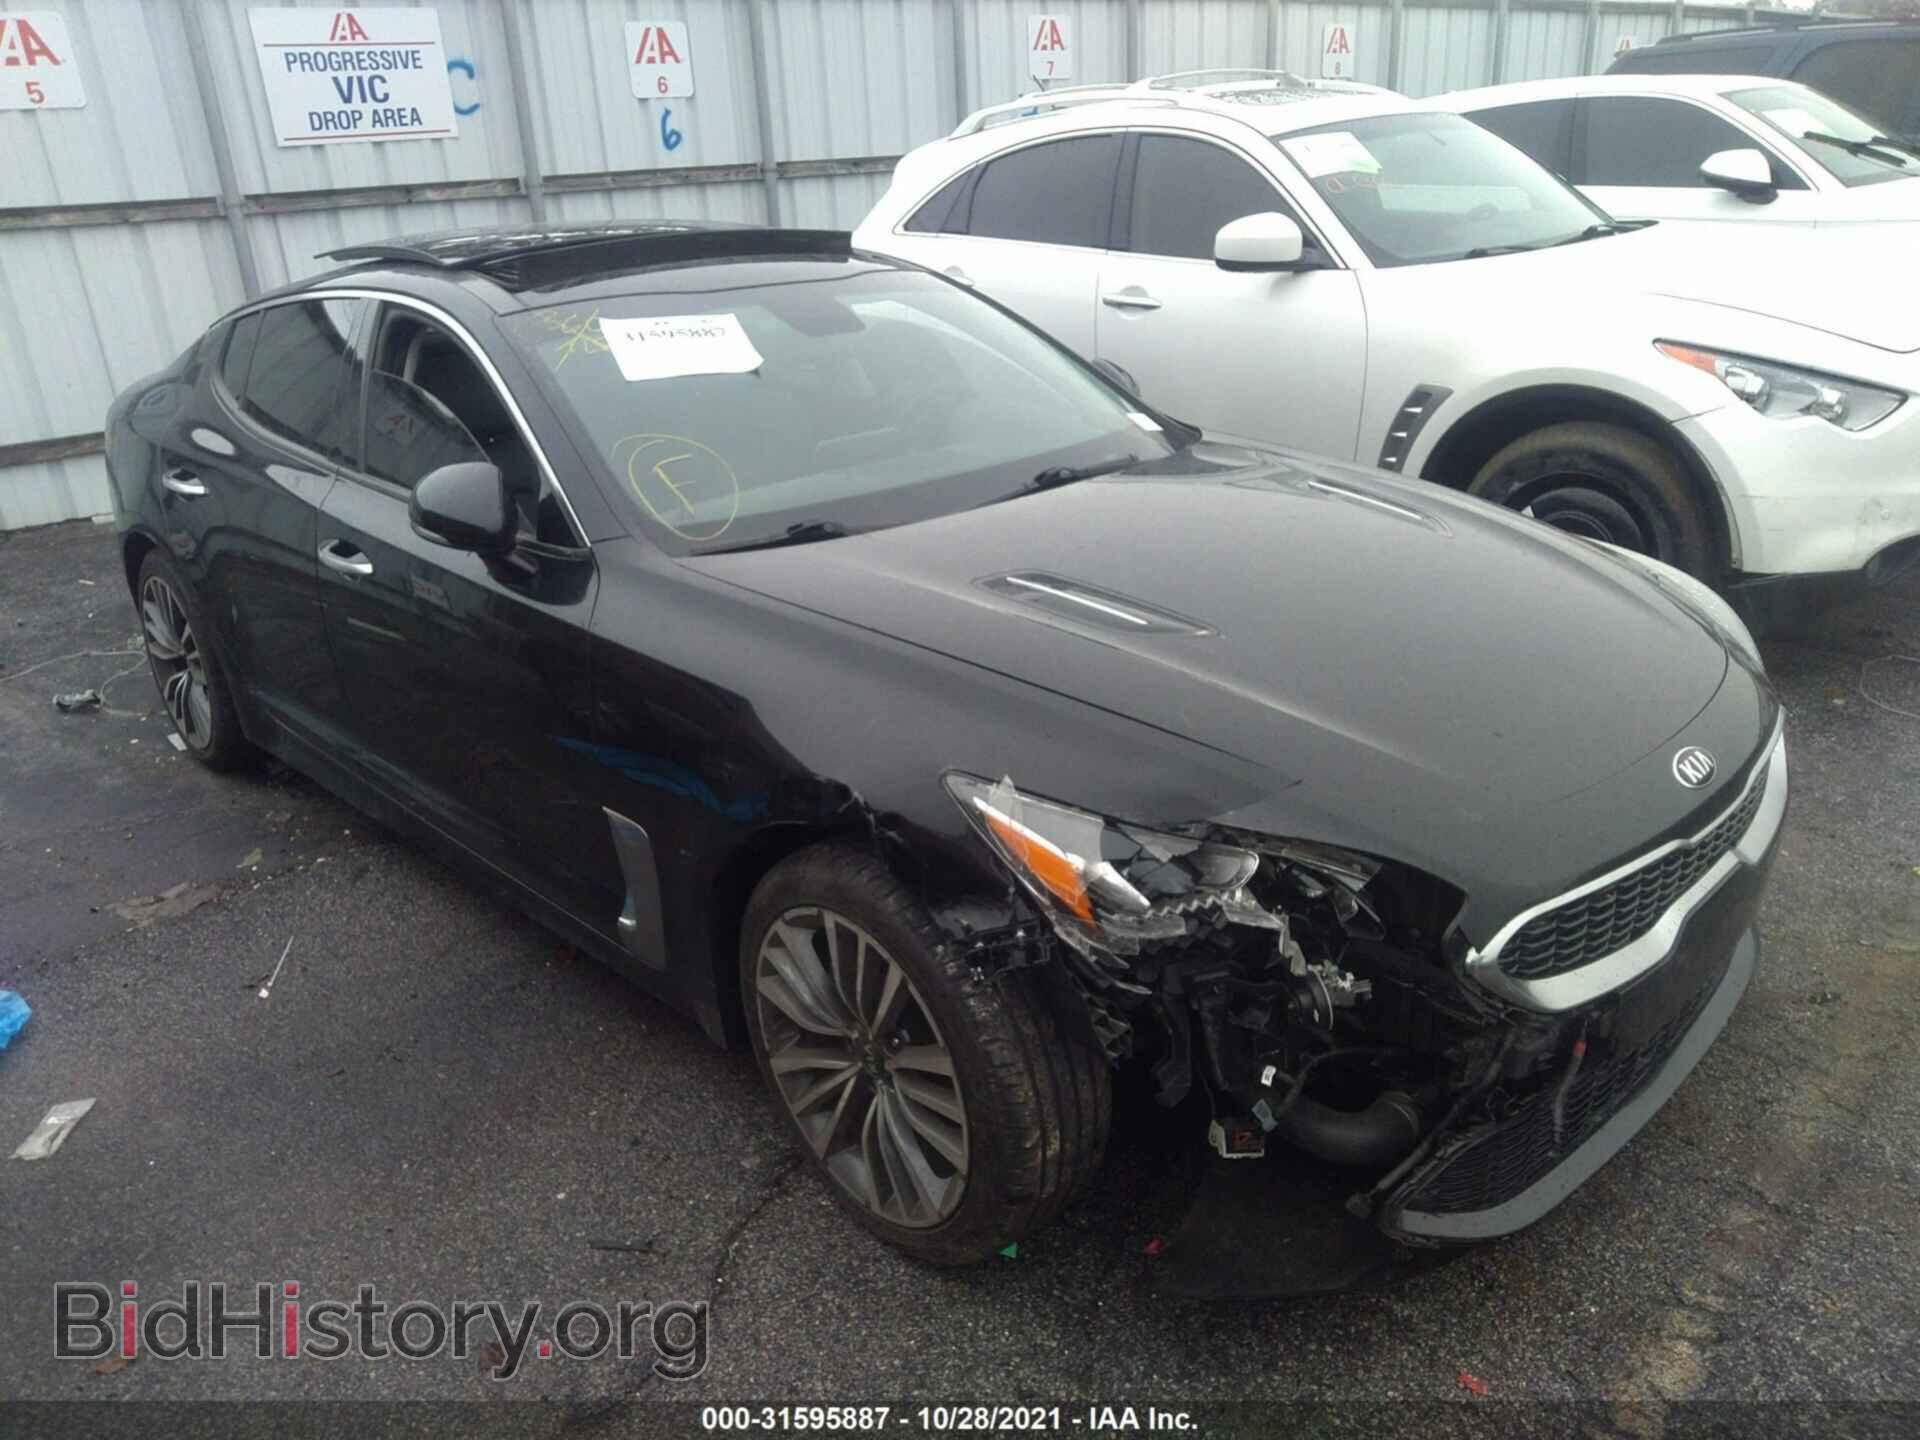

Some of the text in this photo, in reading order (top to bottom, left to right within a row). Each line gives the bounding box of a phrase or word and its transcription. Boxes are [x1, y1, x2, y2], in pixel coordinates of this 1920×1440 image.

[284, 50, 424, 73] PROGRESSIVE
[1046, 61, 1055, 76] 7
[25, 81, 45, 104] 5
[331, 74, 390, 104] VIC
[657, 76, 668, 93] 6
[308, 107, 423, 131] DROP AREA
[660, 107, 682, 150] 6
[1678, 750, 1714, 783] KIA
